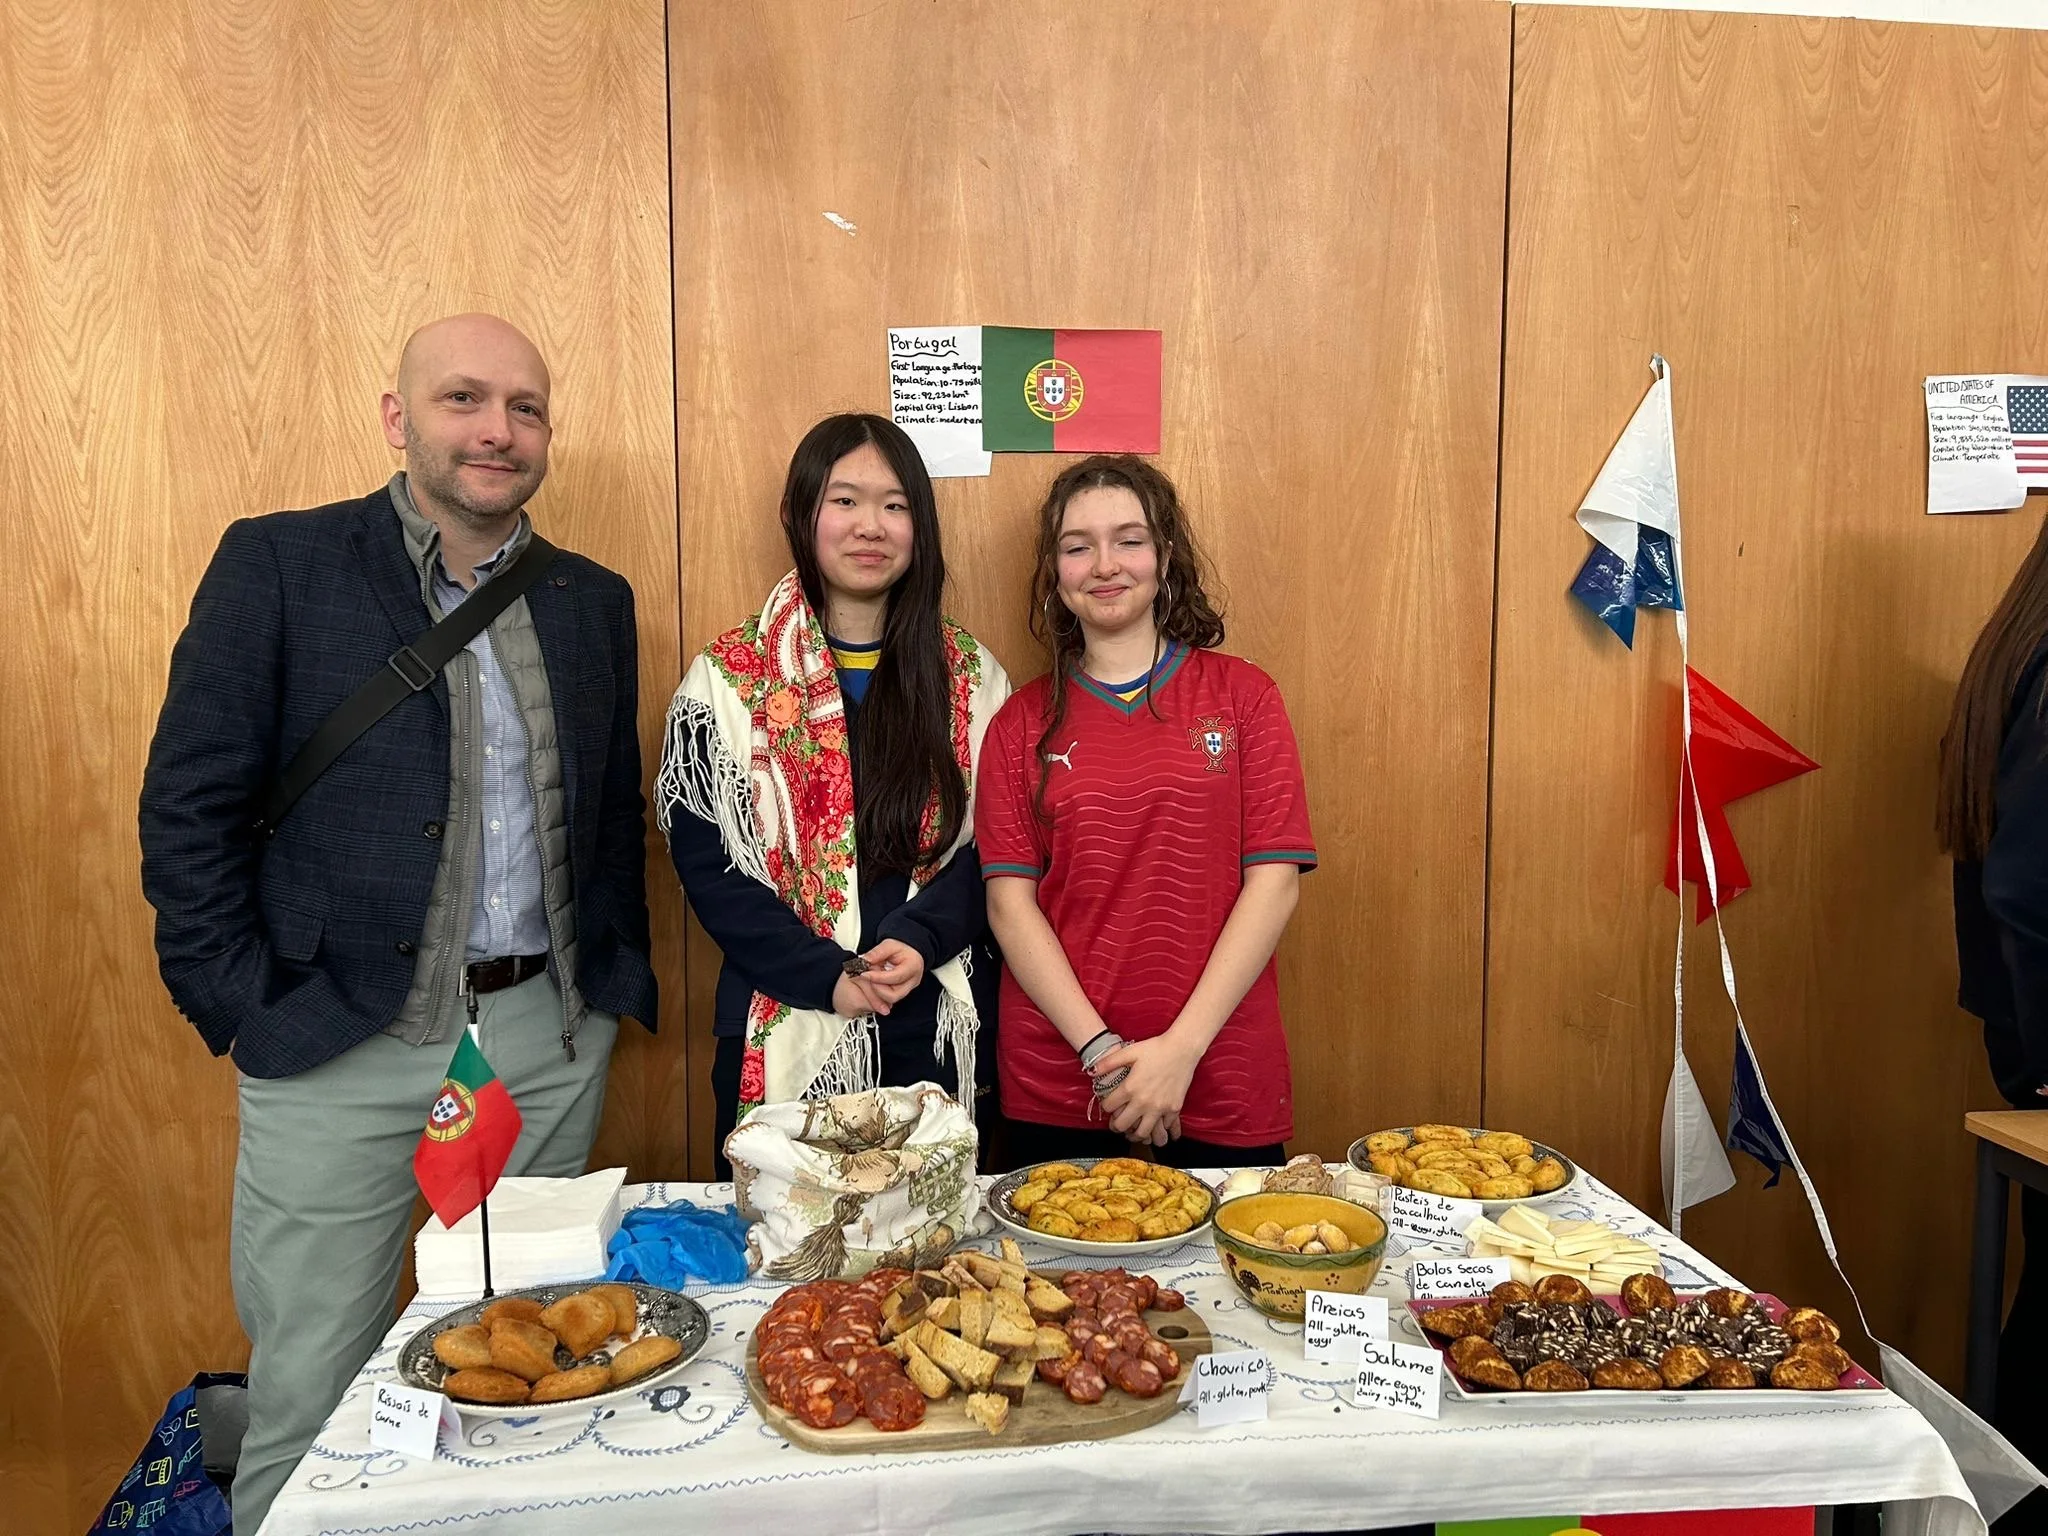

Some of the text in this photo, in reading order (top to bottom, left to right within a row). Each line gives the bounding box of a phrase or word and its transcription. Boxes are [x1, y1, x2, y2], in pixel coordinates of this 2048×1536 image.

[889, 332, 957, 353] Portugal
[891, 360, 910, 371] First
[1928, 379, 1994, 395] UNITED STATES OF
[893, 389, 921, 400] Size:
[1960, 394, 1998, 404] AMERICA
[894, 403, 924, 413] Capital
[948, 401, 979, 411] Lisbon
[894, 414, 939, 424] Climate:
[1962, 451, 2000, 462] Temperate
[1437, 1197, 1454, 1211] de
[1416, 1262, 1452, 1277] Bolos
[1261, 1282, 1306, 1298] Portugal
[1416, 1277, 1486, 1290] de canela
[1312, 1294, 1365, 1320] Areias
[1363, 1342, 1434, 1375] Salame
[418, 1401, 429, 1418] de
[375, 1410, 401, 1428] Carne
